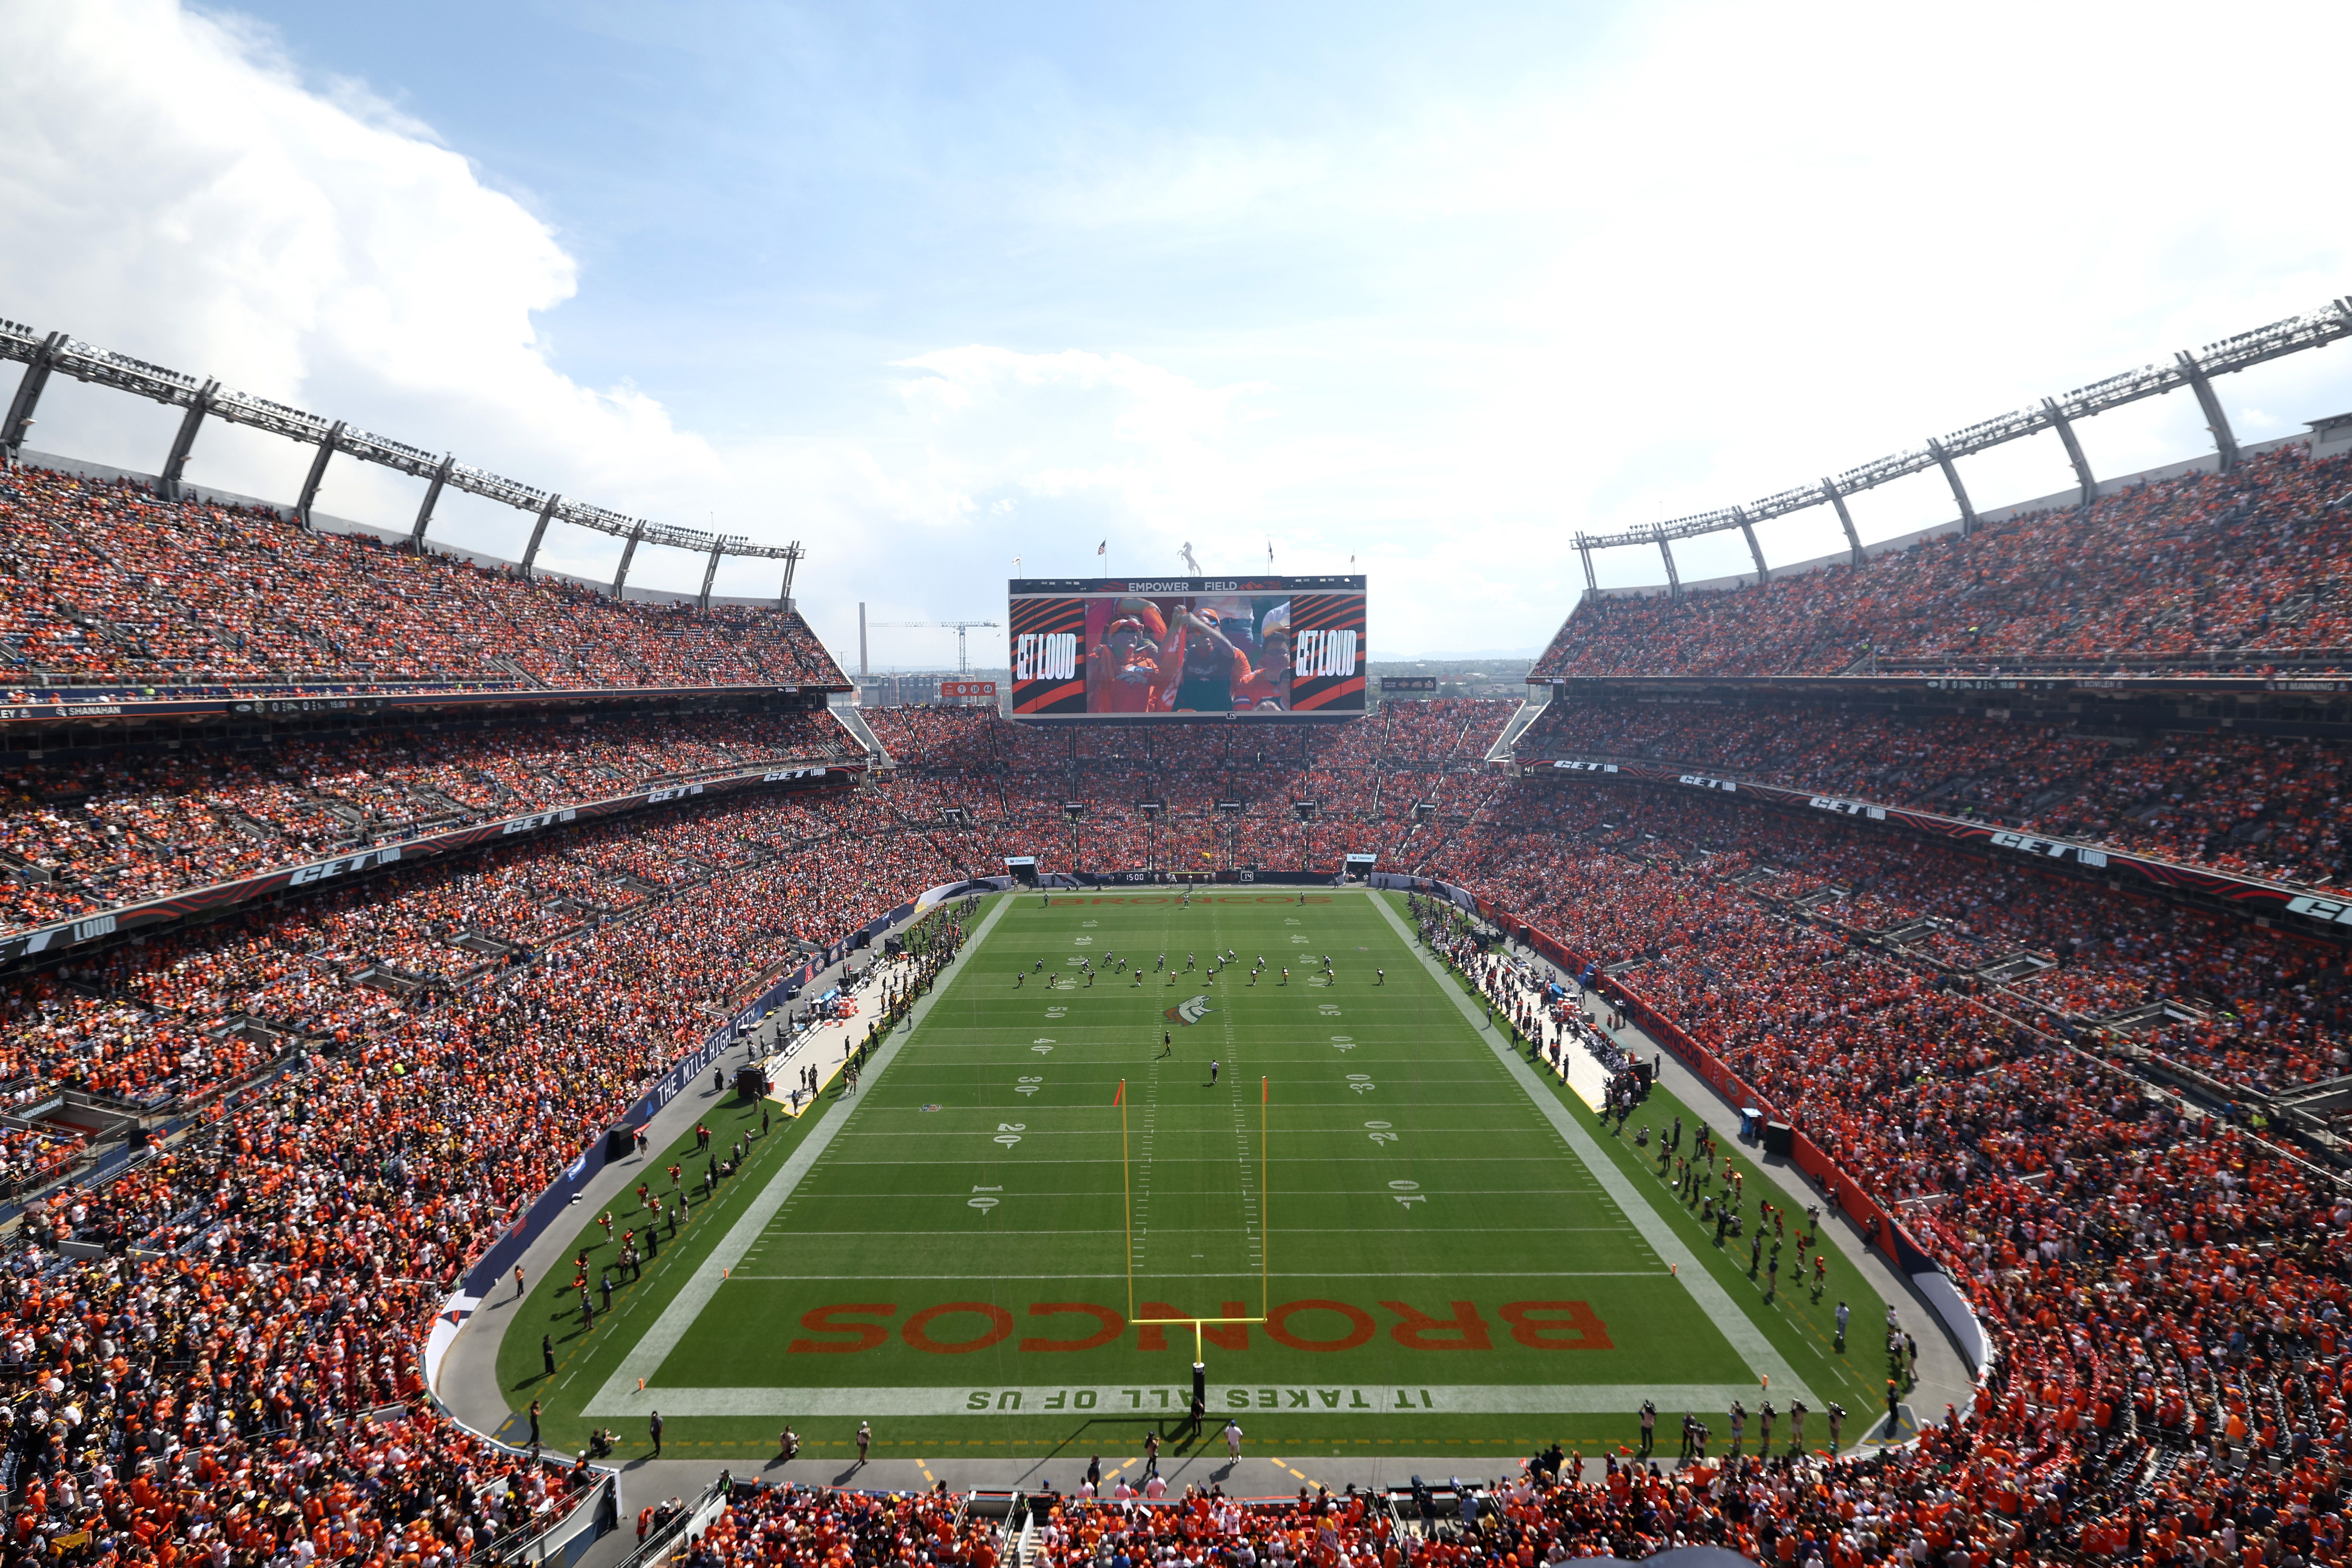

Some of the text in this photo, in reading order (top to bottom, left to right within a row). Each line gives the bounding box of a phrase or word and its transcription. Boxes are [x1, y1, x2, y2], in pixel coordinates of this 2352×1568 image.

[1129, 581, 1238, 592] EMPOWER FIELD
[1017, 633, 1076, 680] GET LOUD
[1296, 630, 1357, 677] GET LOUD
[2289, 682, 2334, 691] MANNING
[69, 706, 122, 716] SHANAHAN
[303, 701, 310, 711] 0
[763, 768, 826, 782] GET LOUD
[1554, 760, 1618, 773] GET LOUD
[1680, 775, 1736, 792] GET LOUD
[648, 785, 703, 803] GET LOUD
[1809, 797, 1886, 820] GET LOUD
[503, 809, 576, 835] GET LOUD
[1990, 835, 2107, 868] GET LOUD
[289, 848, 401, 886] GET LOUD
[1051, 897, 1332, 906] BRONCOS
[73, 915, 116, 942] LOUD
[1542, 939, 1564, 963] HOME
[1567, 955, 1579, 972] OF
[1045, 1006, 1068, 1018] 50
[1318, 1004, 1341, 1016] 50
[1031, 1038, 1056, 1052] 40
[1330, 1036, 1357, 1051] 40
[1647, 1013, 1702, 1069] BRONCOS
[657, 1073, 678, 1106] THE
[683, 1046, 706, 1085] MILE
[709, 1027, 731, 1061] HIGH
[1014, 1076, 1043, 1093] 30
[1346, 1074, 1376, 1090] 30
[993, 1123, 1026, 1143] 20
[1365, 1121, 1399, 1141] 20
[967, 1185, 1003, 1208] 10
[1388, 1180, 1427, 1203] 10
[786, 1299, 1615, 1354] BRONCOS
[966, 1389, 1433, 1410] IT TAKES ALL OF US
[1187, 1524, 1197, 1534] 24
